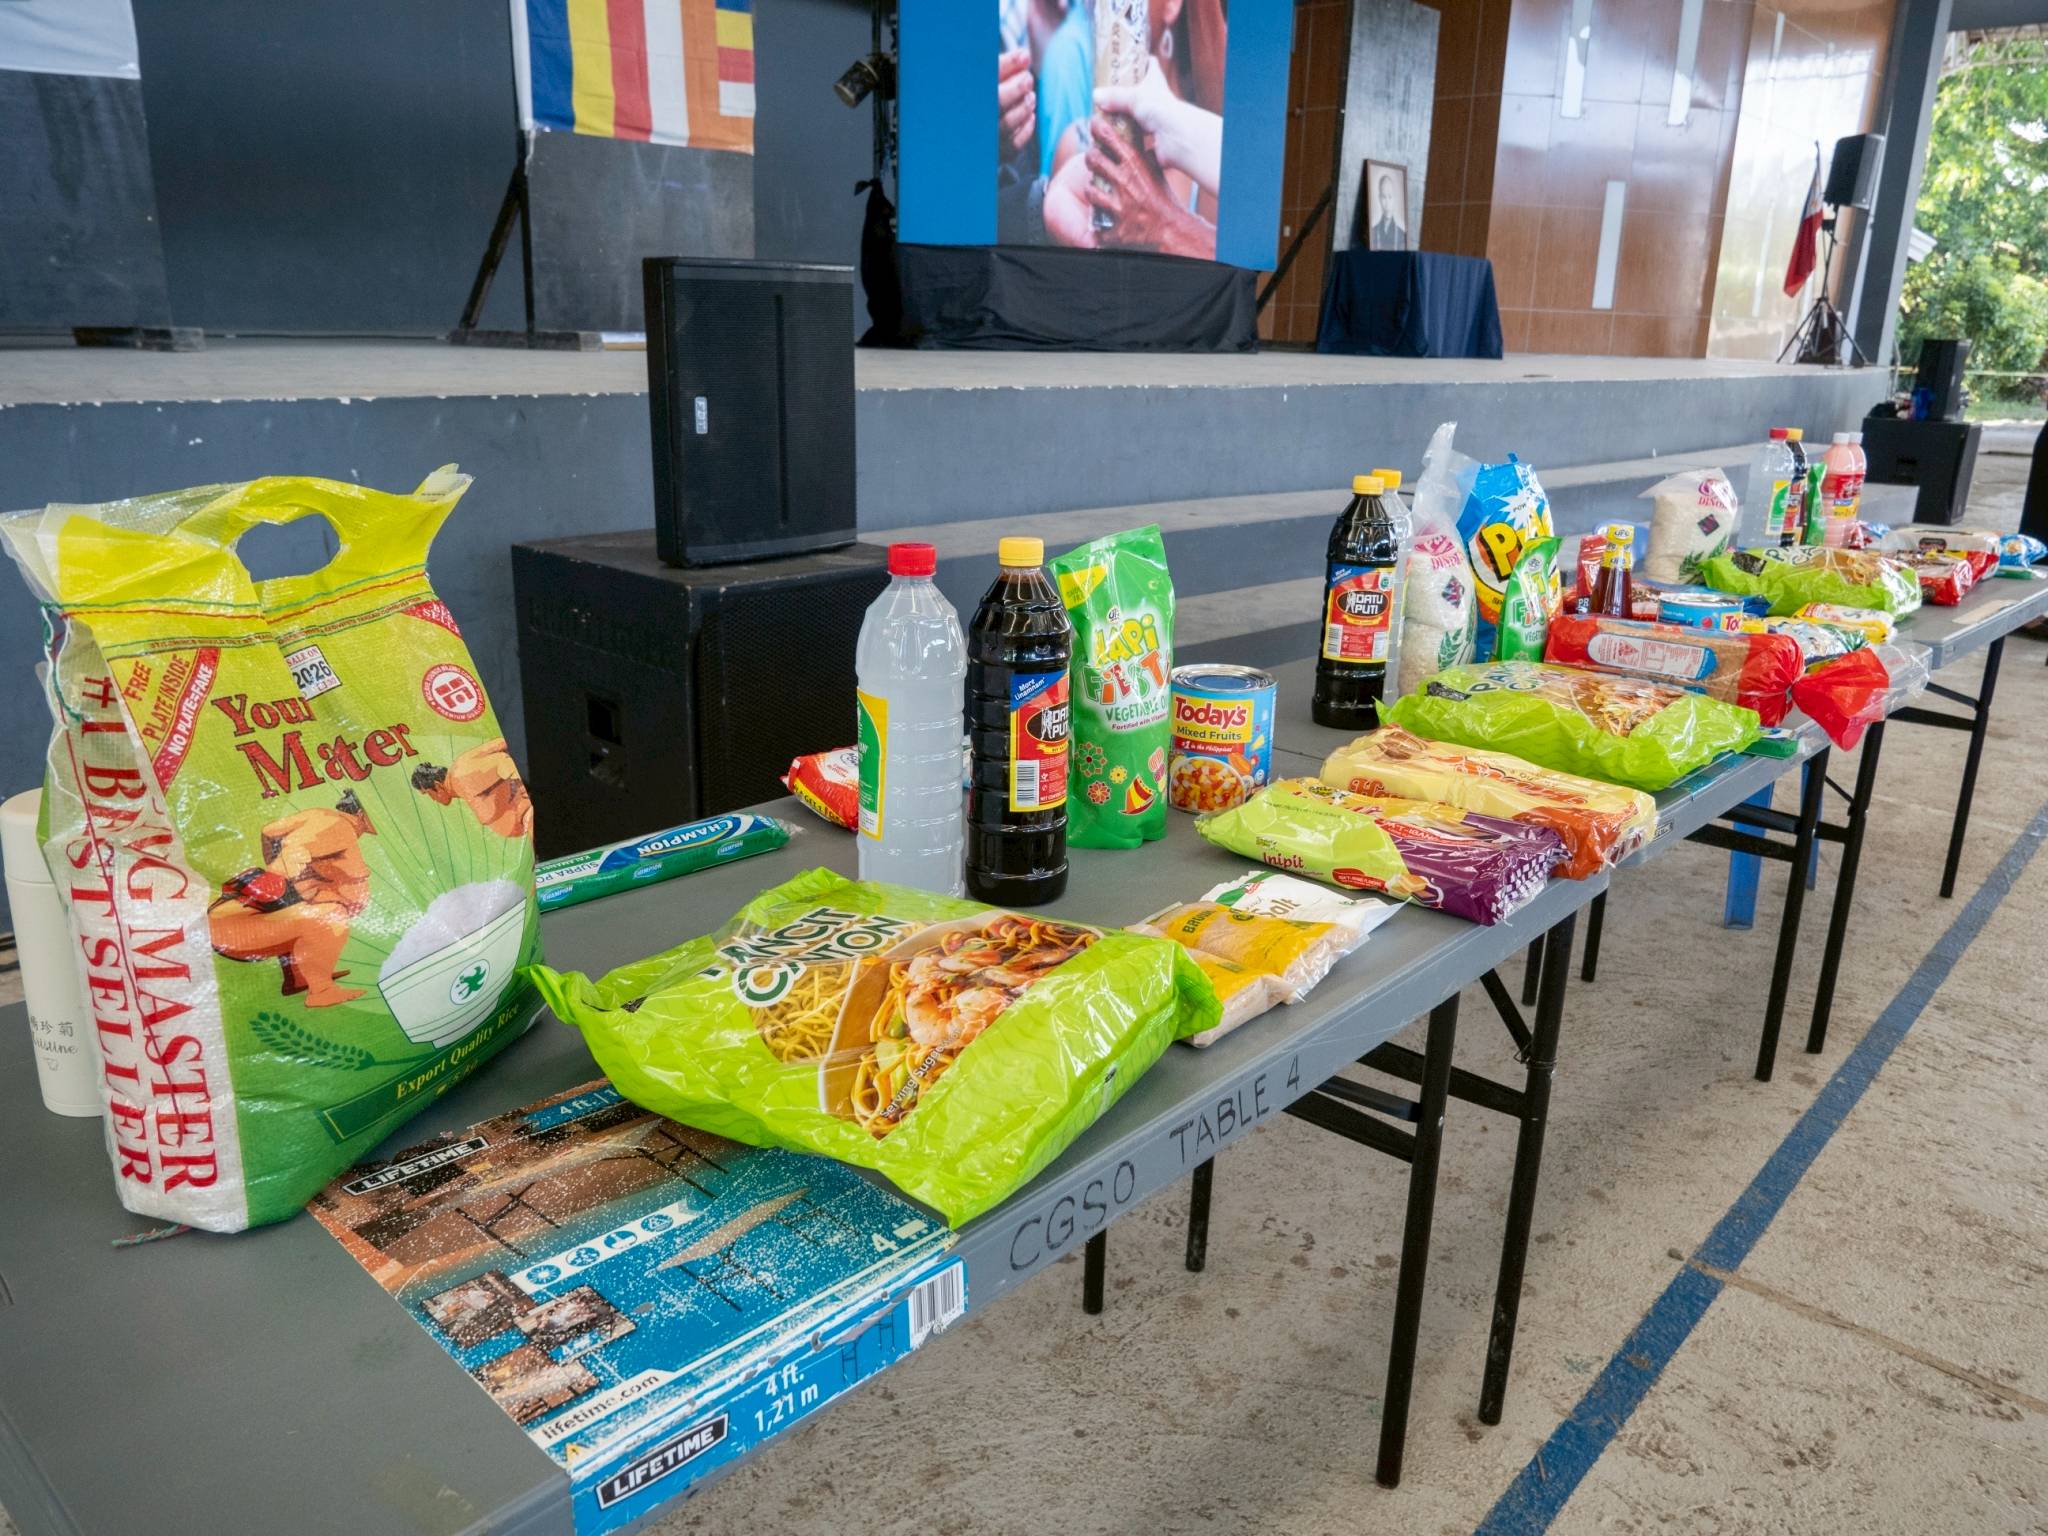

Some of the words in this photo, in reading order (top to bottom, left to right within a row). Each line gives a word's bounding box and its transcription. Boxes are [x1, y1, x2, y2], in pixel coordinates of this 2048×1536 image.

[1355, 605, 1379, 614] PUTI
[1356, 594, 1383, 604] DATU
[124, 661, 152, 702] FREE
[292, 659, 332, 690] 2026
[1019, 678, 1036, 692] More
[142, 695, 176, 742] PLATE
[159, 653, 192, 699] INSIDE
[1105, 698, 1157, 721] VEGETABLE
[1175, 696, 1247, 730] Today's
[1112, 720, 1139, 731] Fortified
[1176, 725, 1207, 739] Mixed
[1209, 731, 1242, 741] Fruits
[168, 734, 187, 757] NO
[636, 820, 734, 855] CHAMPION
[557, 860, 600, 878] SUPRA
[1263, 852, 1305, 870] Inipit
[79, 933, 153, 1186] SELLER
[127, 923, 218, 1195] MASTER
[396, 1057, 447, 1099] Export
[450, 1026, 494, 1066] Quality
[497, 1003, 520, 1030] Rice
[880, 1076, 919, 1118] Serving
[362, 1143, 474, 1189] LIFETIME
[1009, 1159, 1136, 1272] CGSO
[1169, 1072, 1271, 1165] TABLE
[1286, 1054, 1301, 1091] 4
[765, 1374, 780, 1397] 4
[781, 1362, 806, 1386] ft.
[800, 1383, 819, 1406] m
[541, 1373, 661, 1441] lifetime.com
[613, 1423, 715, 1498] LIFETIME
